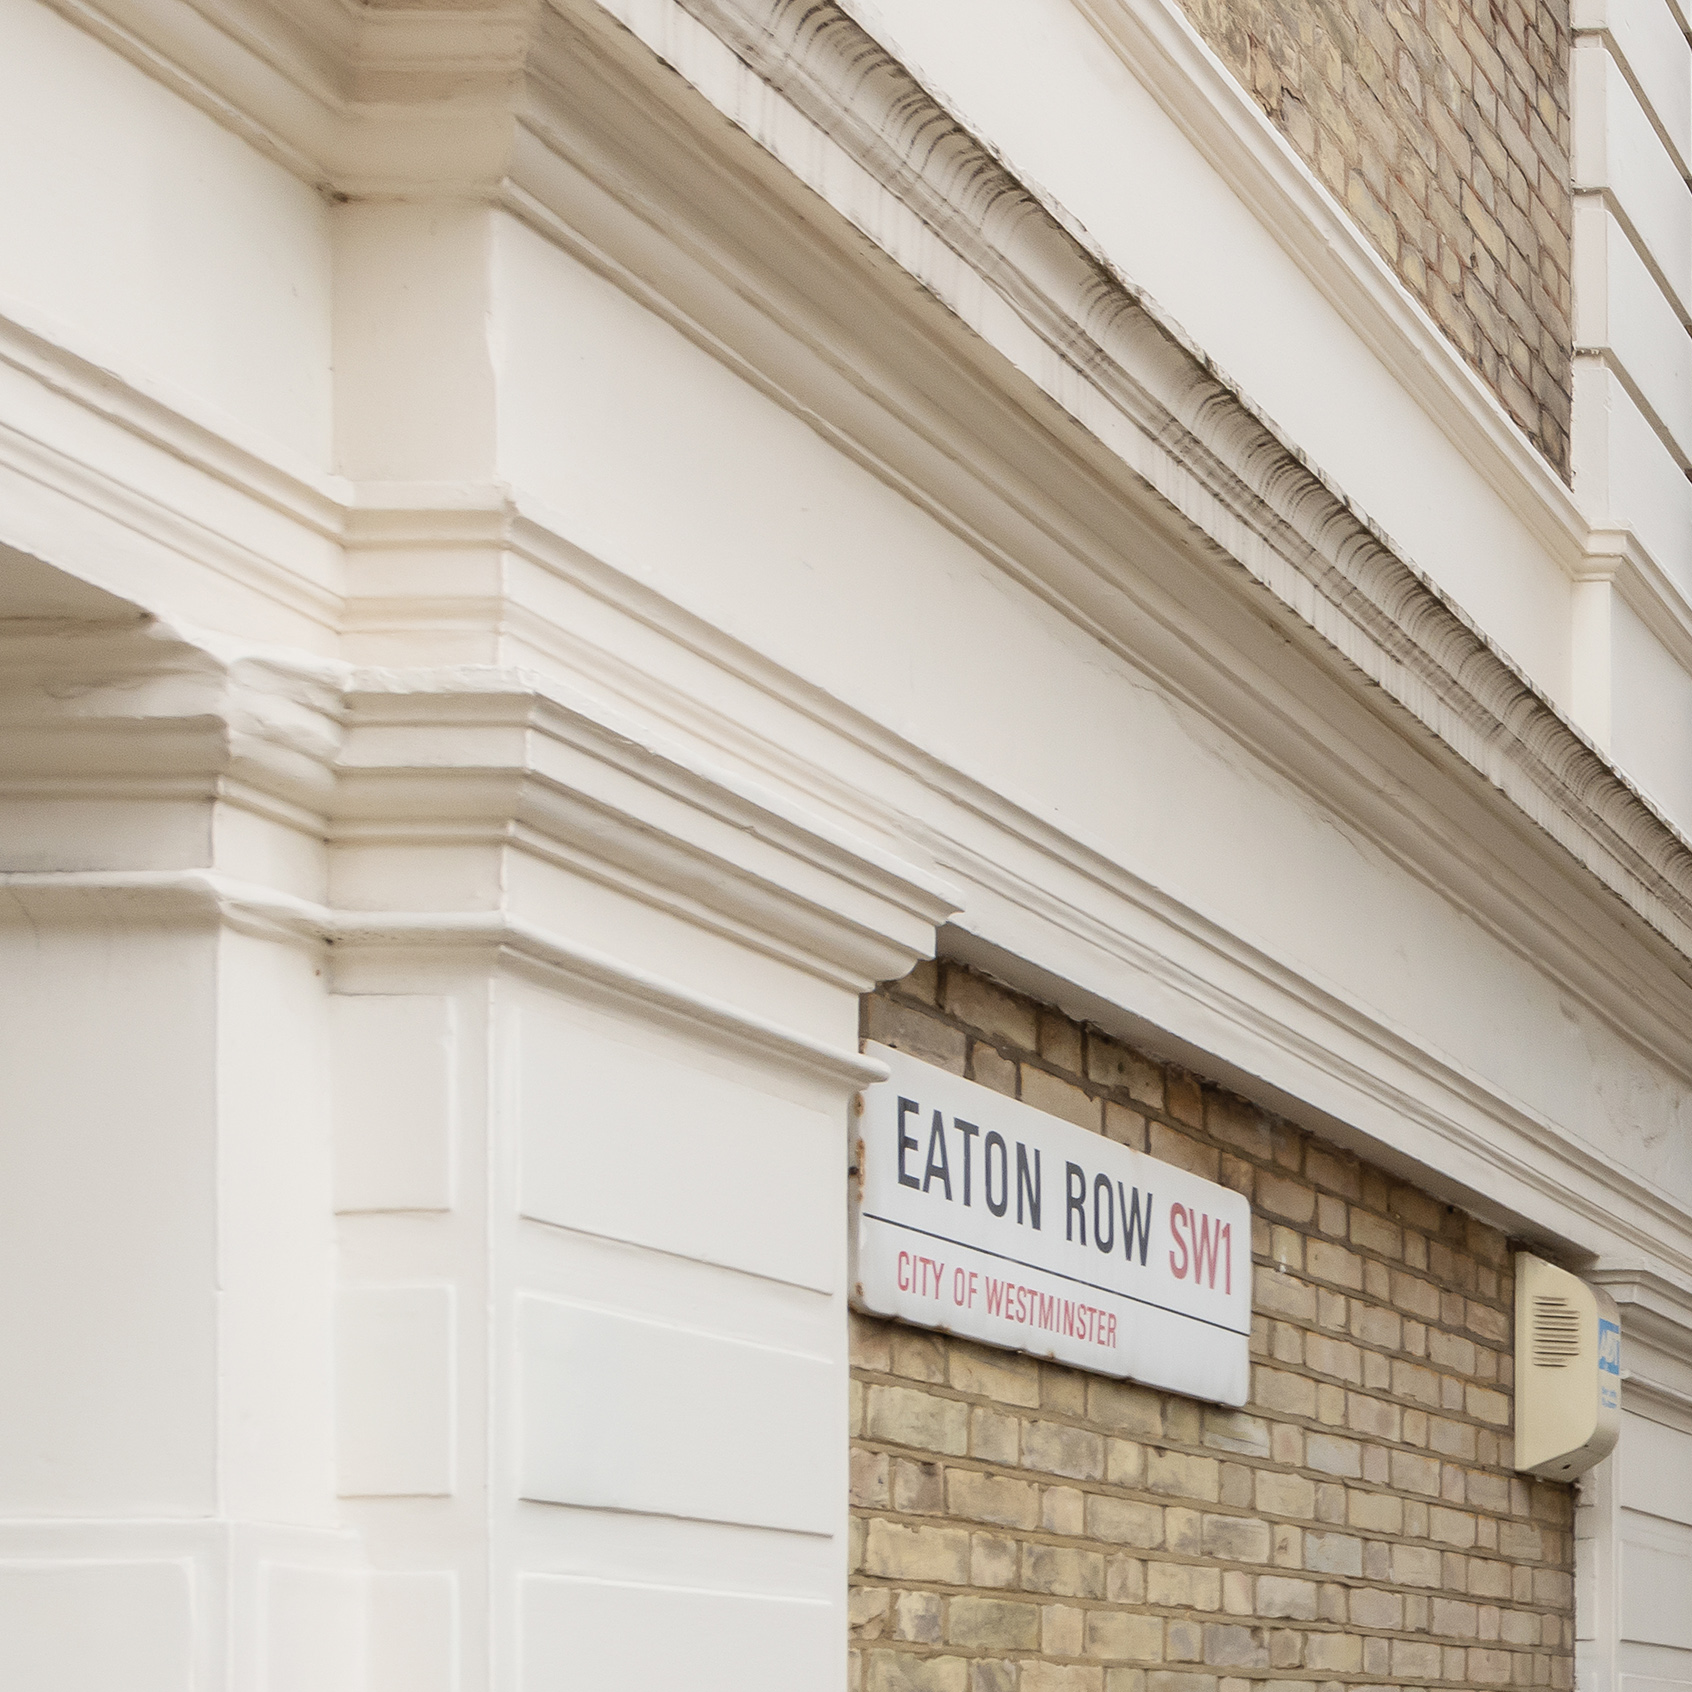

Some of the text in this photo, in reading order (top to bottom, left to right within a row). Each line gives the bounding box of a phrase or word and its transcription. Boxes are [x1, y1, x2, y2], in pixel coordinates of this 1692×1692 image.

[897, 1095, 1232, 1295] EATON ROW SW1
[897, 1250, 1117, 1349] CITY OF WESTMINSTER
